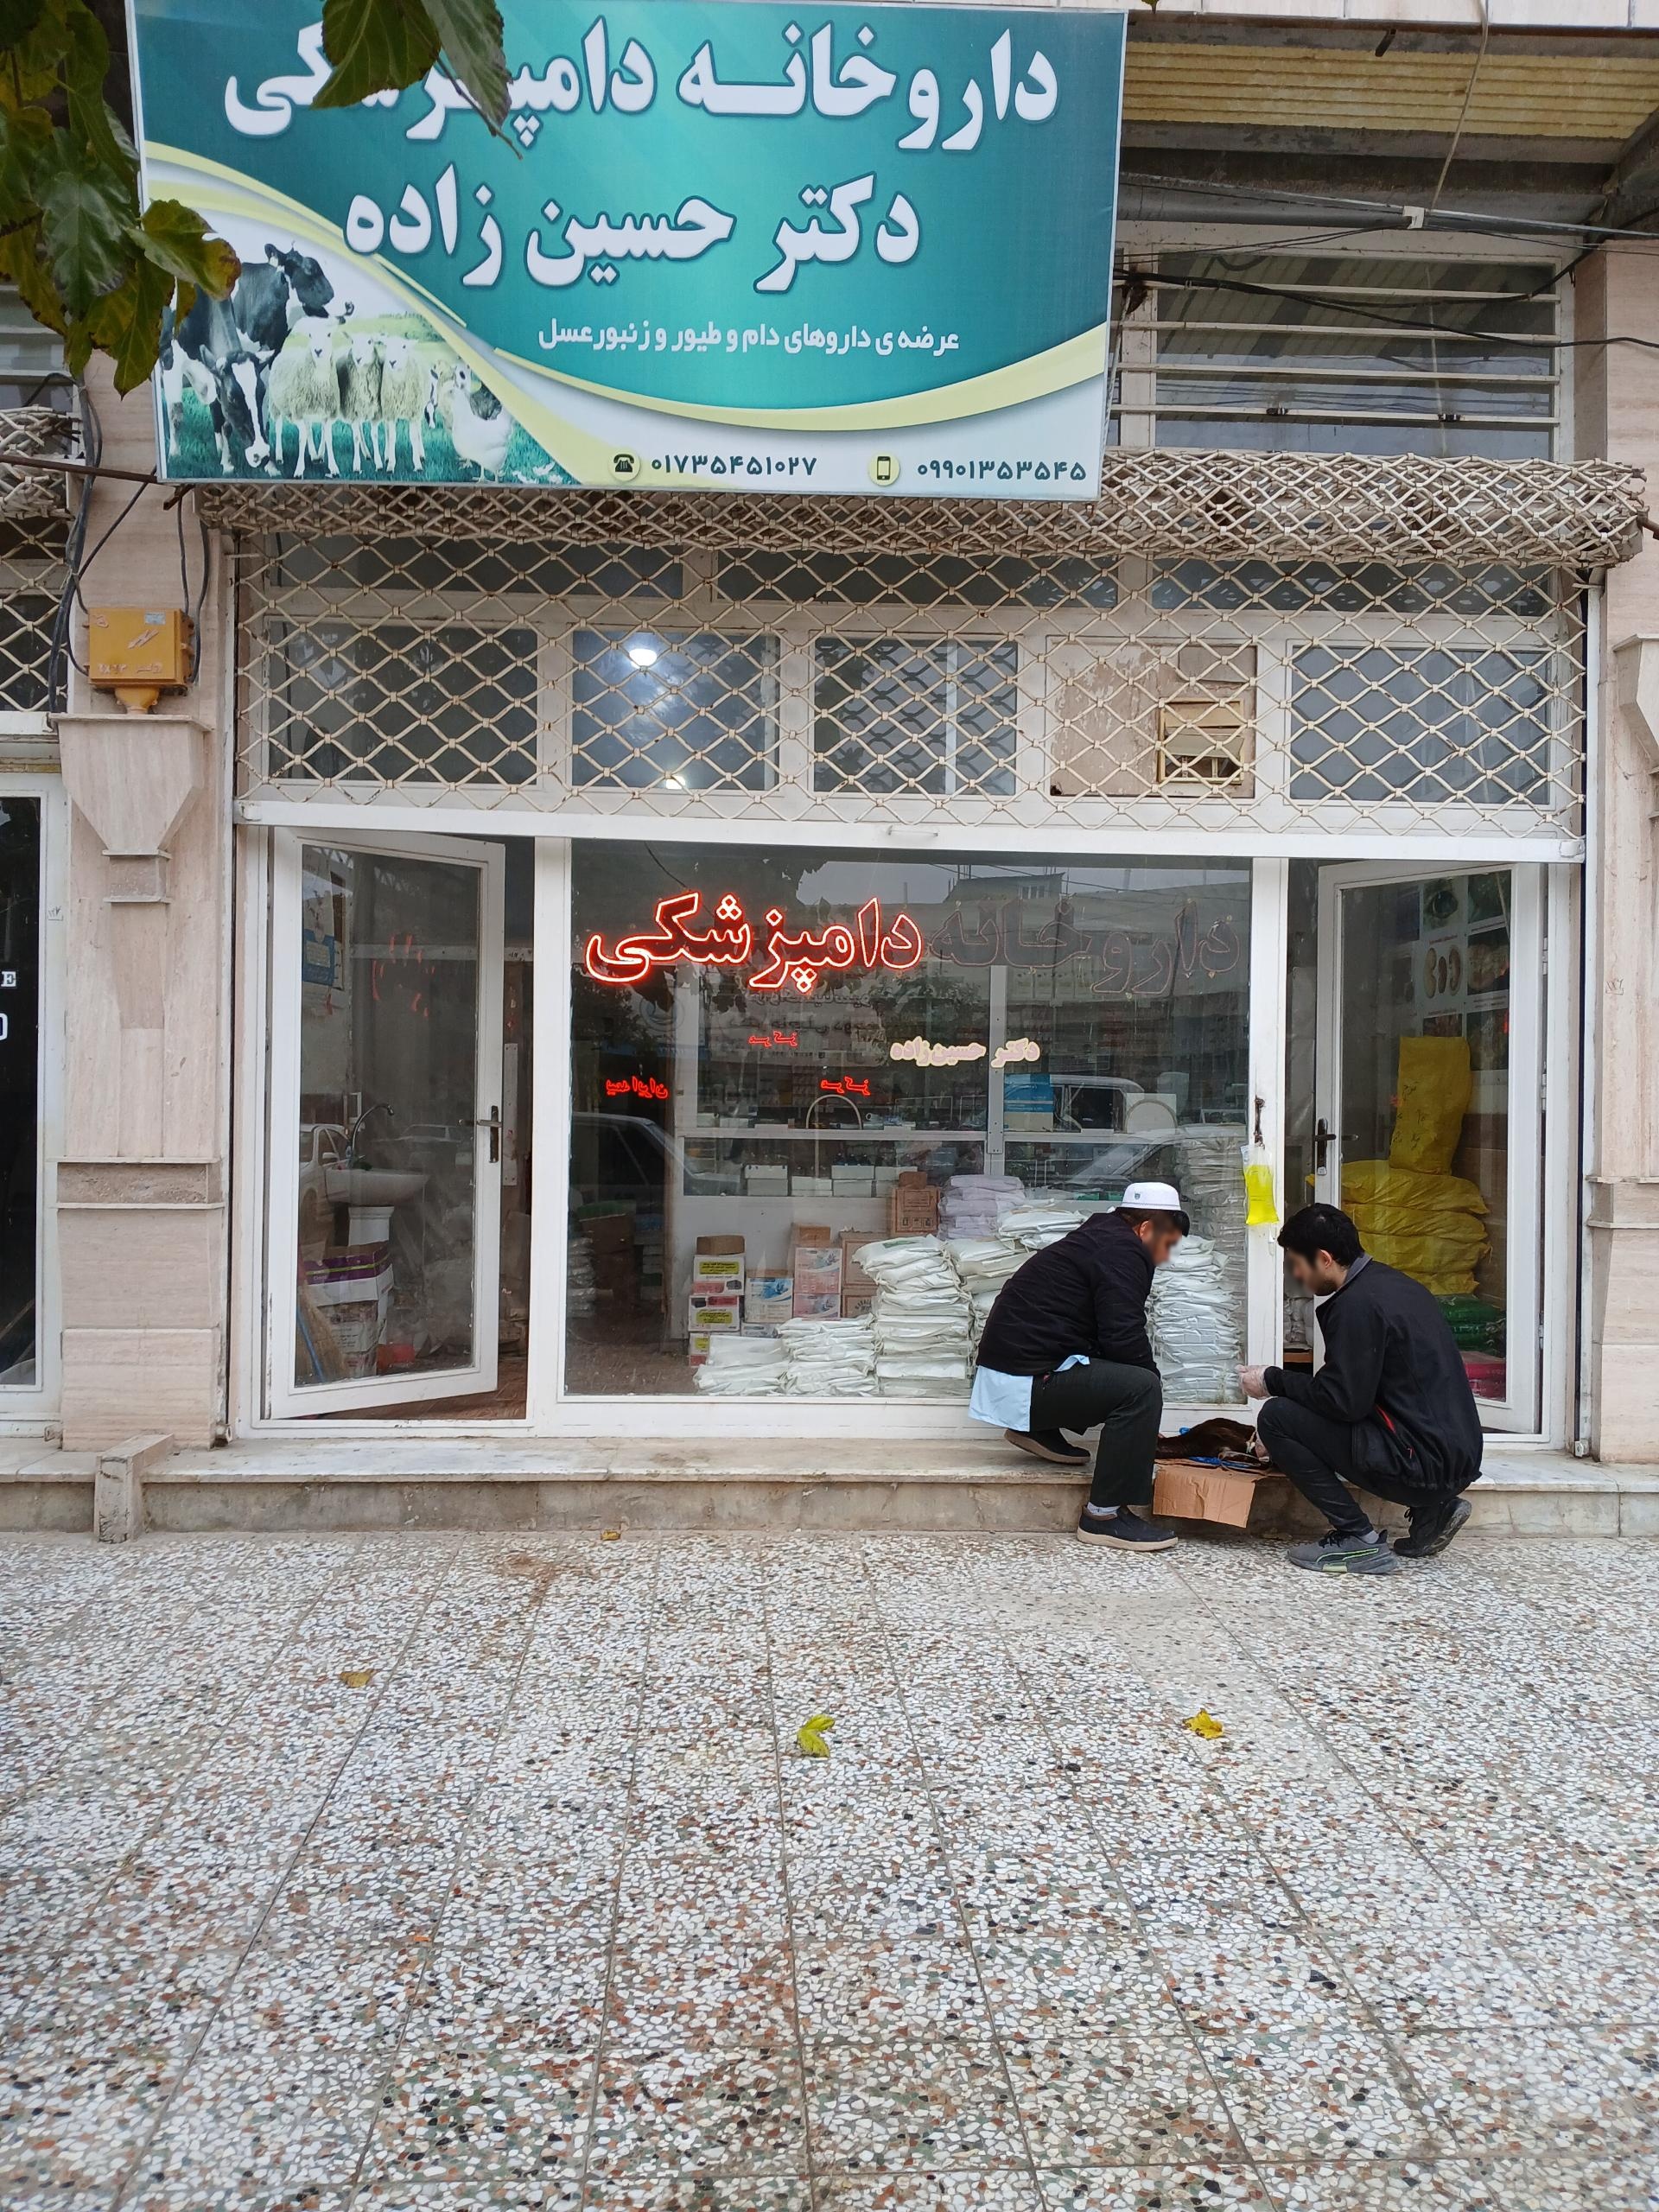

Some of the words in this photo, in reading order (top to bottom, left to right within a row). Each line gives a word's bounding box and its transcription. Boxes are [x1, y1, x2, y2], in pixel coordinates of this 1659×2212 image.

[346, 162, 503, 287] زاده
[755, 173, 919, 292] دکتر
[526, 196, 735, 287] حسین
[654, 327, 667, 351] و
[671, 321, 722, 352] طیور
[726, 327, 738, 353] و
[742, 323, 779, 353] دام
[784, 322, 871, 355] داروهای
[651, 454, 817, 476] ۰۱۷۳۵۴۵۱۰۲۷
[916, 459, 1087, 481] ۰۹۹۰۱۳۵۳۵۴۵
[585, 891, 923, 994] دامپزشکی
[890, 1036, 931, 1066] زاده
[931, 1042, 986, 1066] حسین
[991, 1038, 1040, 1068] دکتر
